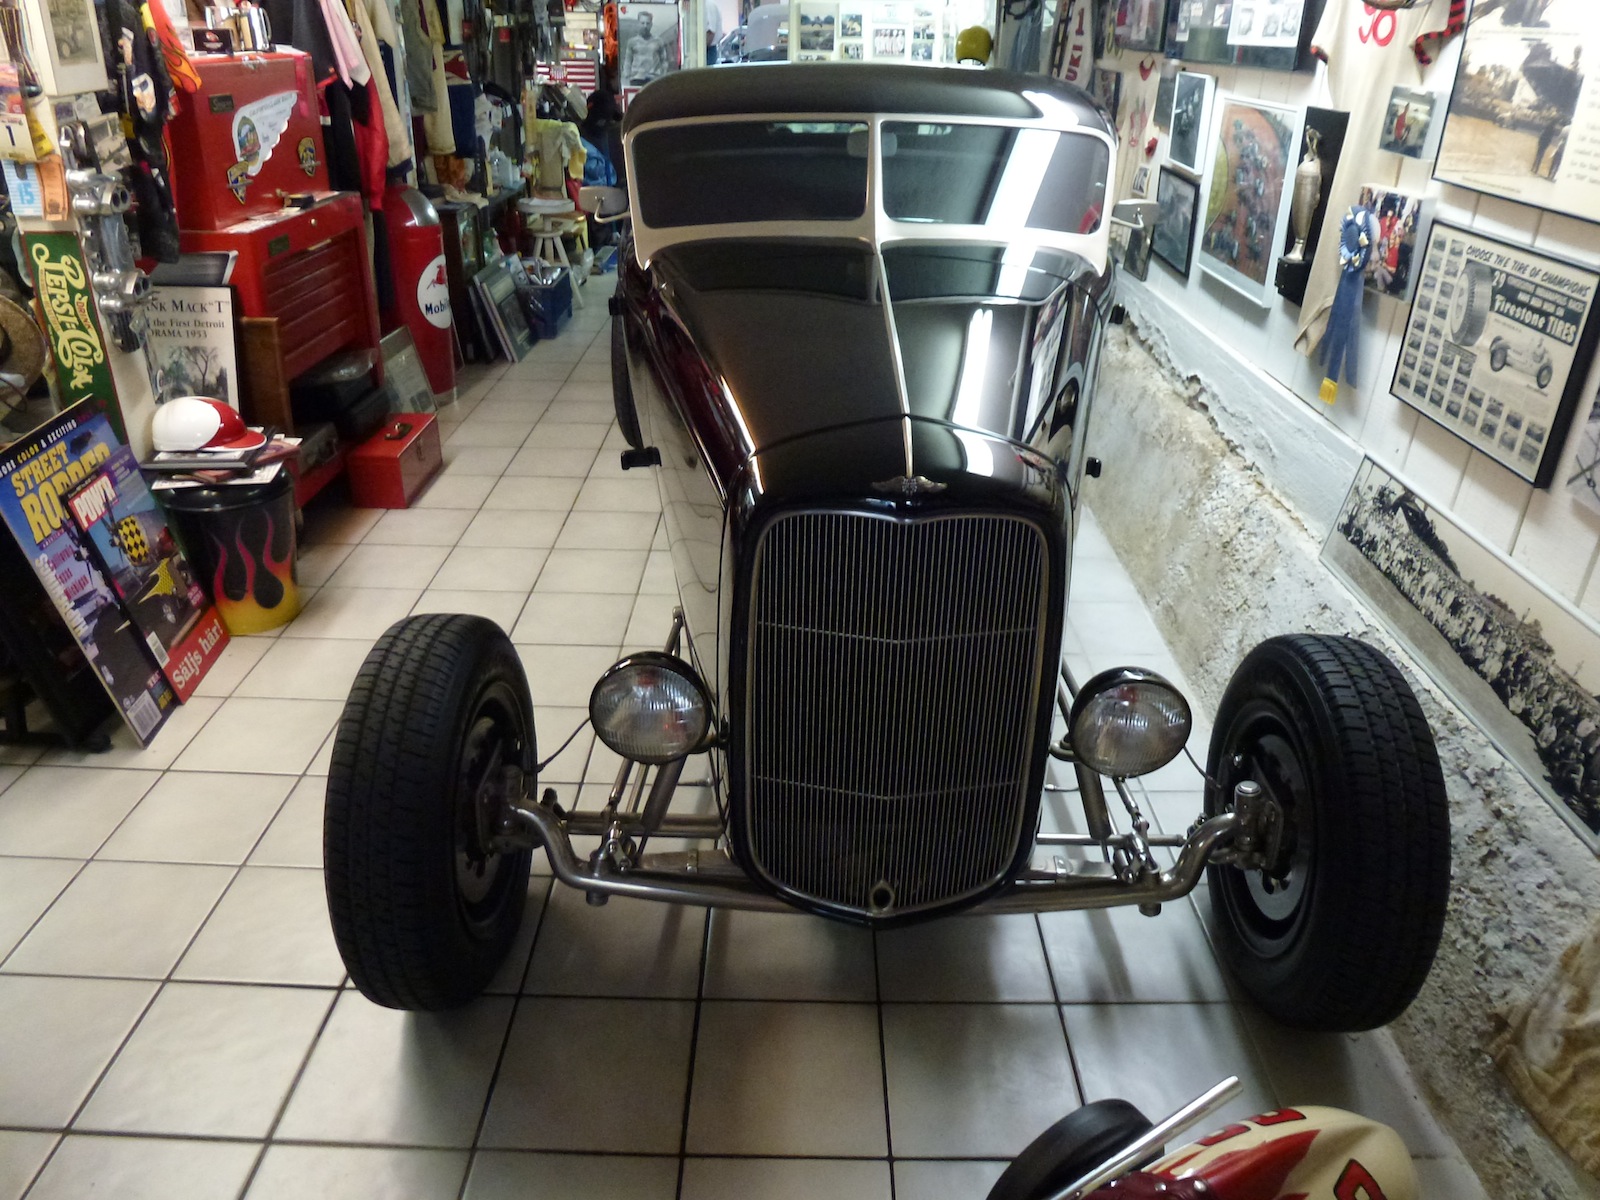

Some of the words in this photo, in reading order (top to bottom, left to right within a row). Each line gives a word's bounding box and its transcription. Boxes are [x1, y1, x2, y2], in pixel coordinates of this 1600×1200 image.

[1466, 245, 1495, 263] CHOOSE
[1495, 250, 1511, 268] THE
[1511, 259, 1530, 275] TIRE
[1529, 265, 1542, 278] OF
[1541, 270, 1592, 298] CHAMPIONS
[153, 317, 166, 328] the
[169, 318, 190, 328] First
[194, 319, 225, 329] Detroit
[186, 329, 208, 339] 1953
[1494, 293, 1546, 329] Firestone
[1546, 314, 1577, 344] TIRES
[11, 441, 69, 497] STREET
[172, 648, 203, 690] Säljs
[198, 618, 224, 656] här!
